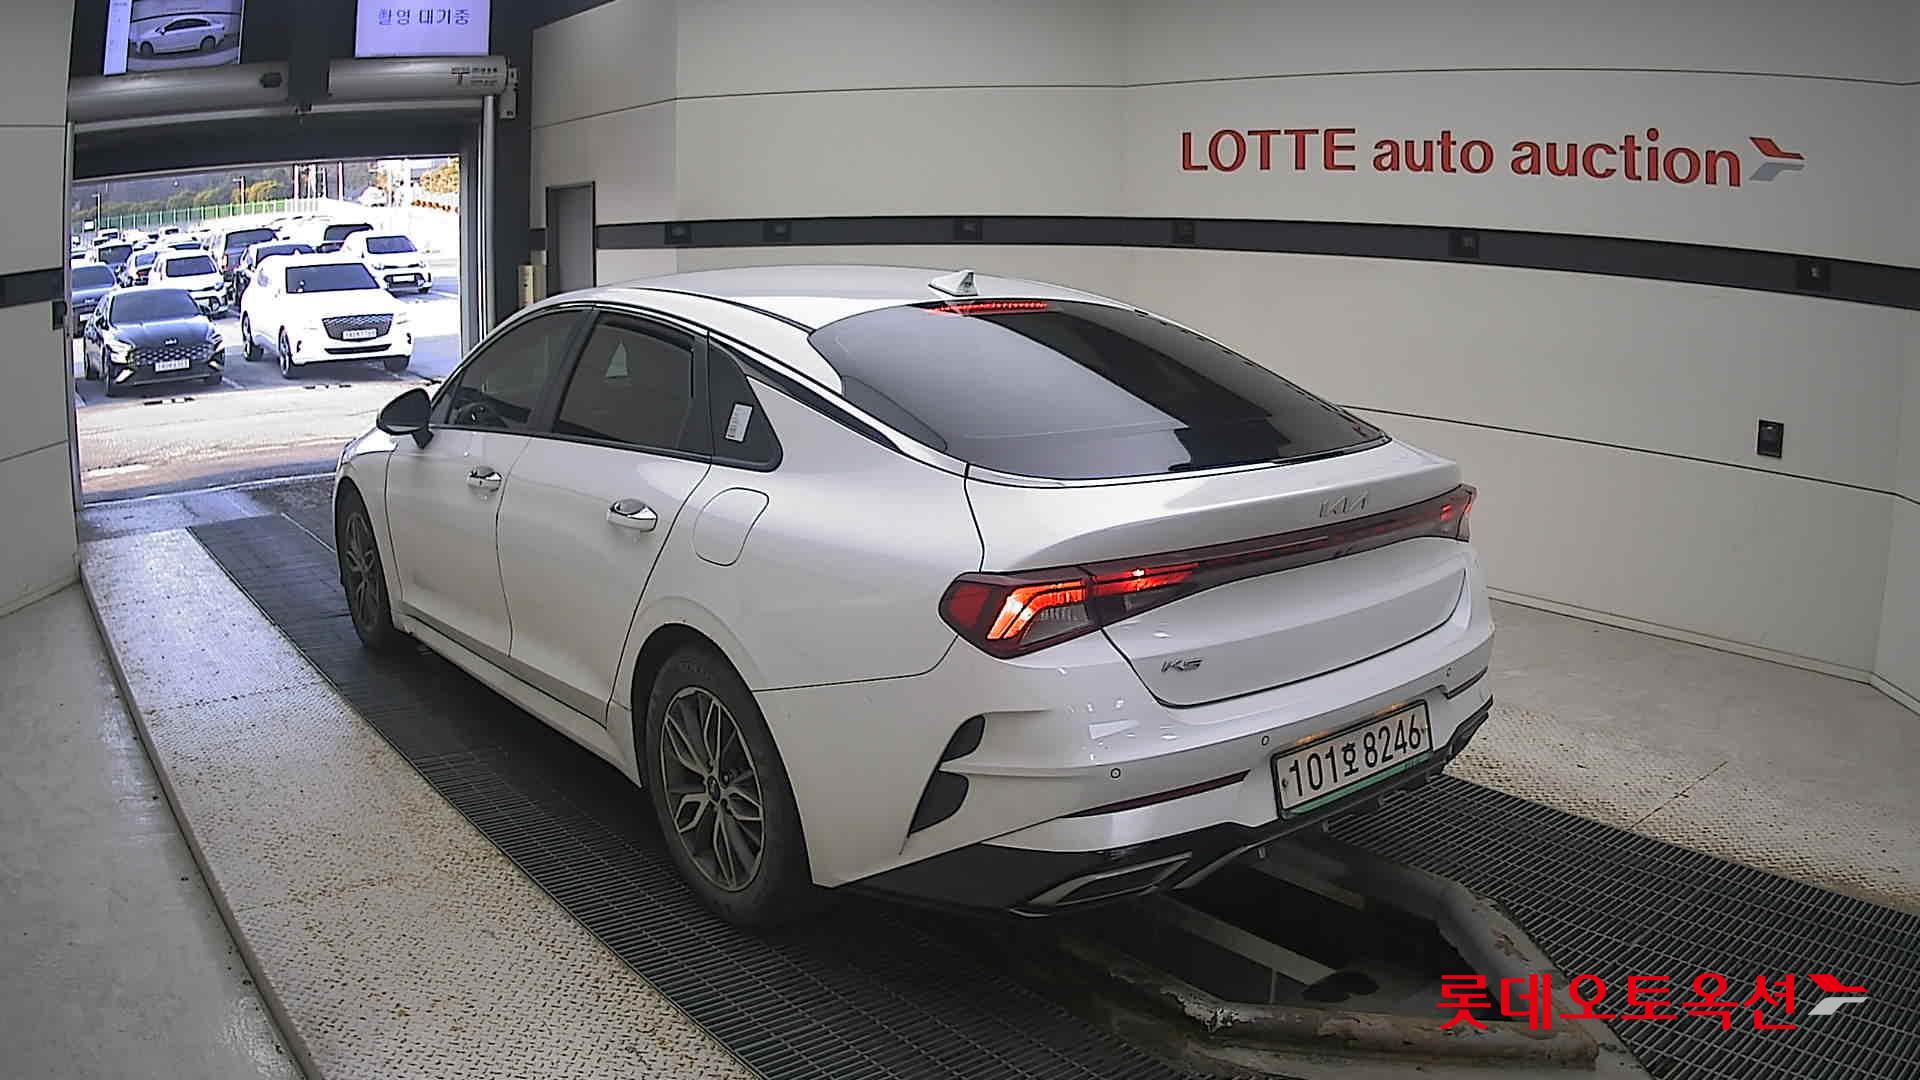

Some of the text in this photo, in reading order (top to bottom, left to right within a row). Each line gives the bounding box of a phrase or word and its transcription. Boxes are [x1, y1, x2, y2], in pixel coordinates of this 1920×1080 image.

[419, 8, 469, 25] 대기중
[1182, 128, 1741, 187] LOTTE auto auction
[1161, 659, 1202, 672] K5
